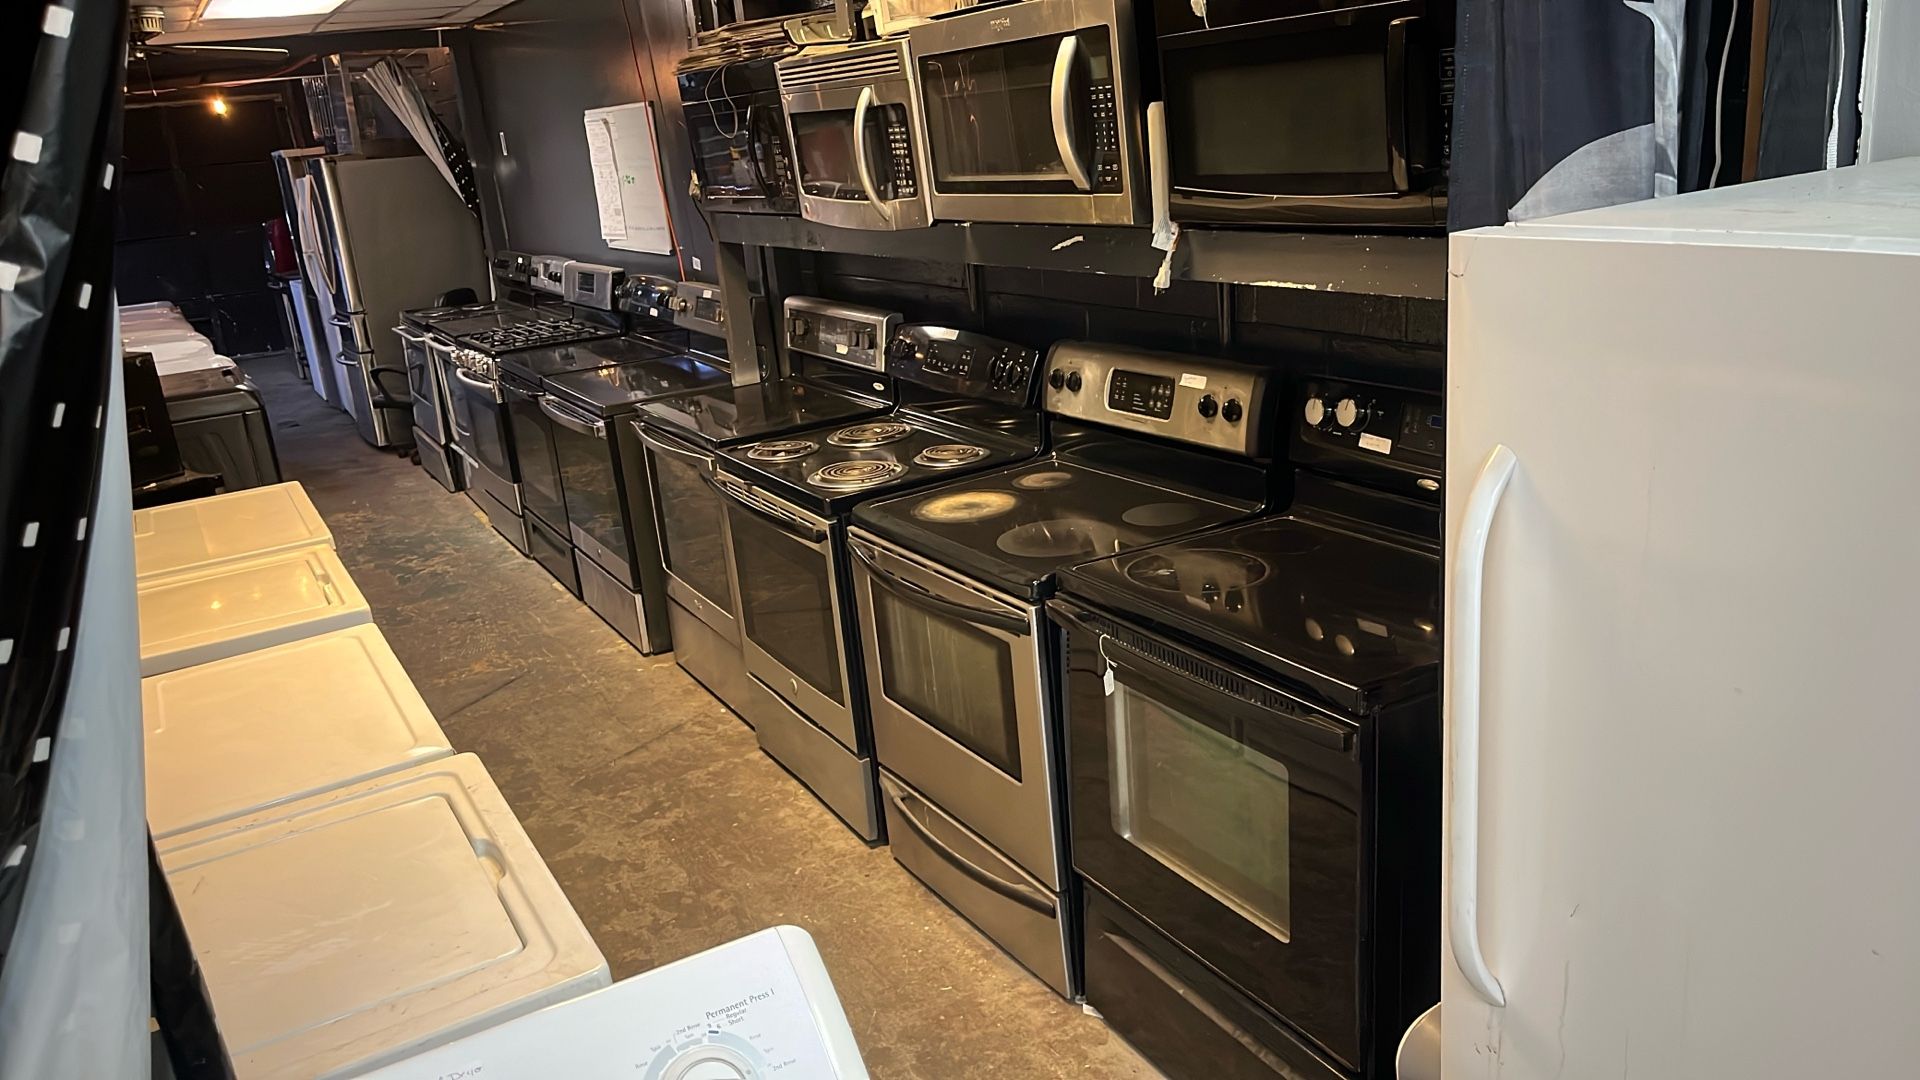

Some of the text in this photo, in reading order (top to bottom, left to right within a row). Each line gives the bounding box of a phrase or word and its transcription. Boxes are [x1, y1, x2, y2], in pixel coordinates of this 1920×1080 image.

[705, 999, 749, 1020] Permanent
[748, 991, 770, 1004] Press
[725, 1008, 747, 1019] Regular
[728, 1016, 745, 1026] Short
